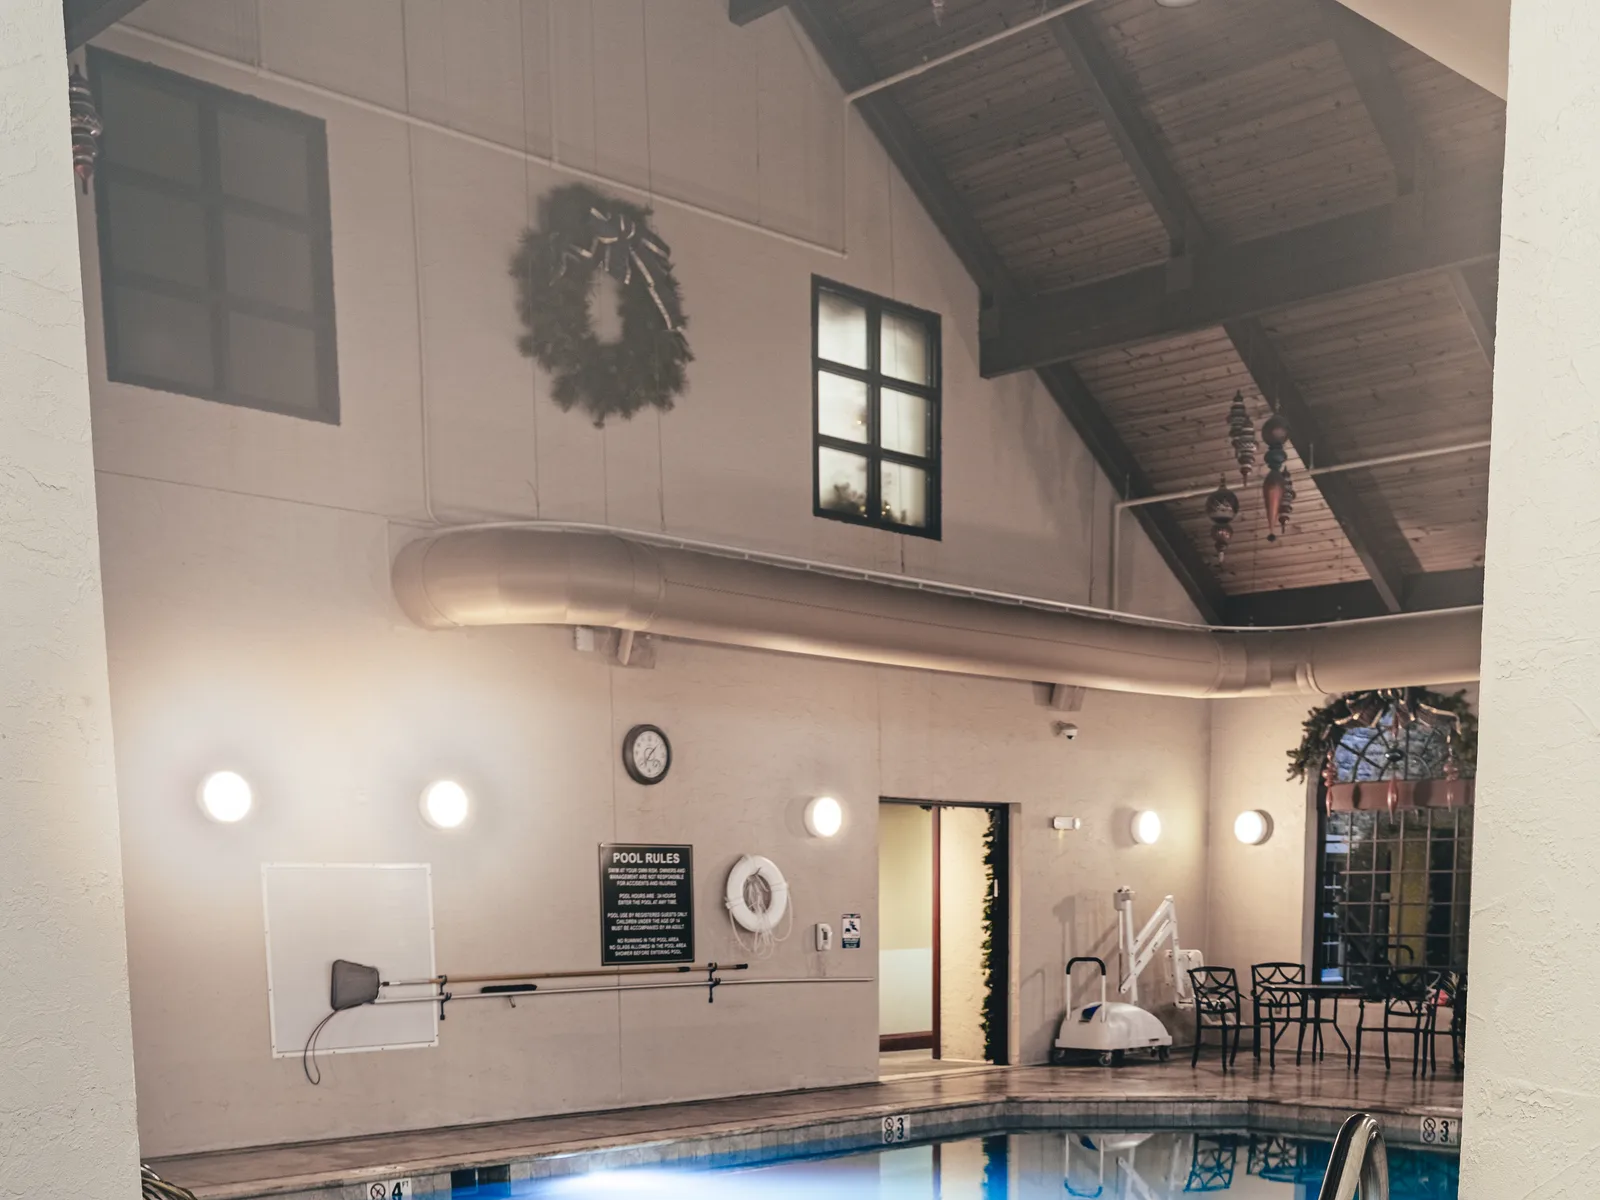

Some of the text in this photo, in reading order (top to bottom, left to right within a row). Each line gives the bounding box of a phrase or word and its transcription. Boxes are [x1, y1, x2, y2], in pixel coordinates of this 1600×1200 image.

[612, 852, 680, 864] POOL RULES
[897, 1117, 904, 1131] 3
[1440, 1120, 1449, 1133] 3
[392, 1182, 402, 1196] 4
